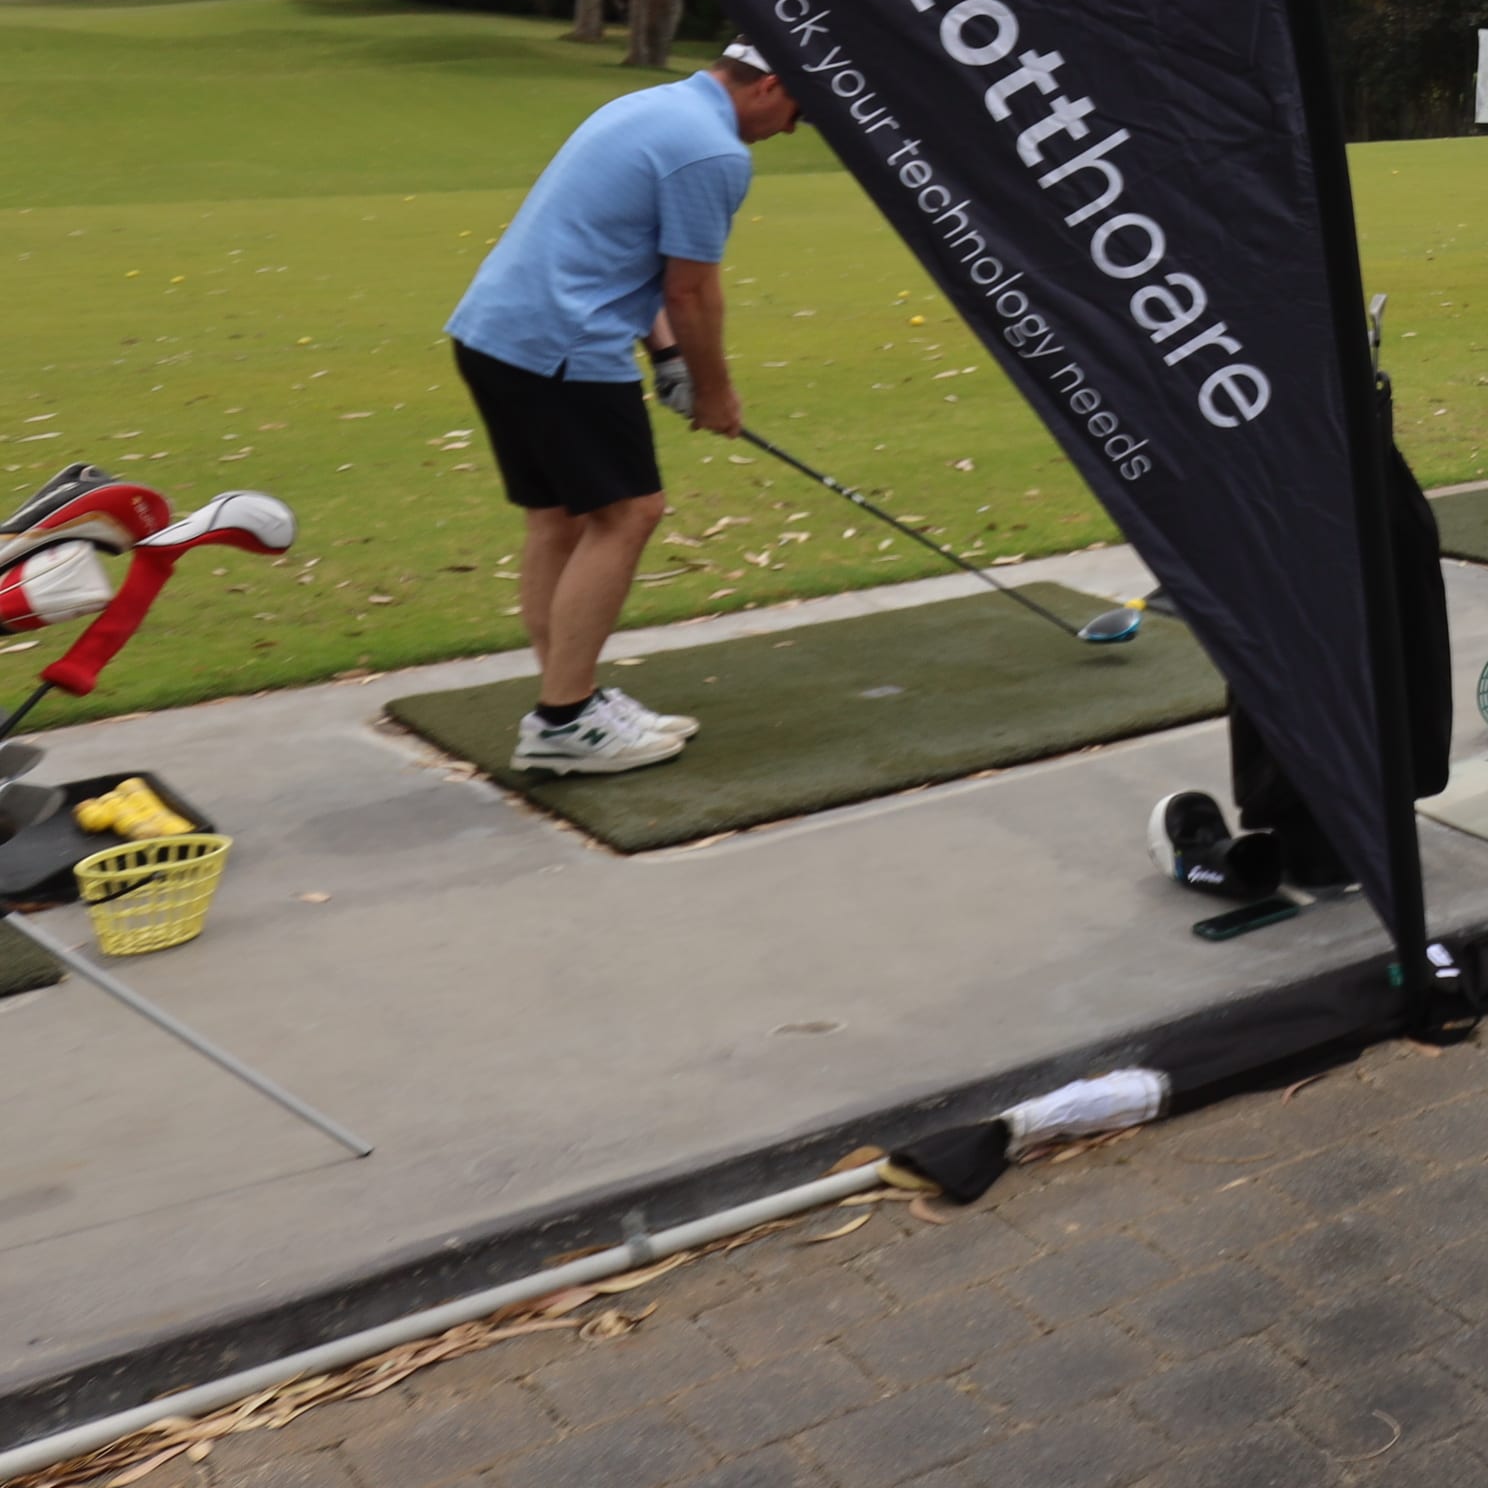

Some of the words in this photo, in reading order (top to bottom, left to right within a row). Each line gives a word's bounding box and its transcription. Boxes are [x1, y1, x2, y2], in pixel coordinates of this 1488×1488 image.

[804, 44, 899, 141] your
[887, 137, 1064, 360] technology
[1049, 359, 1153, 482] needs
